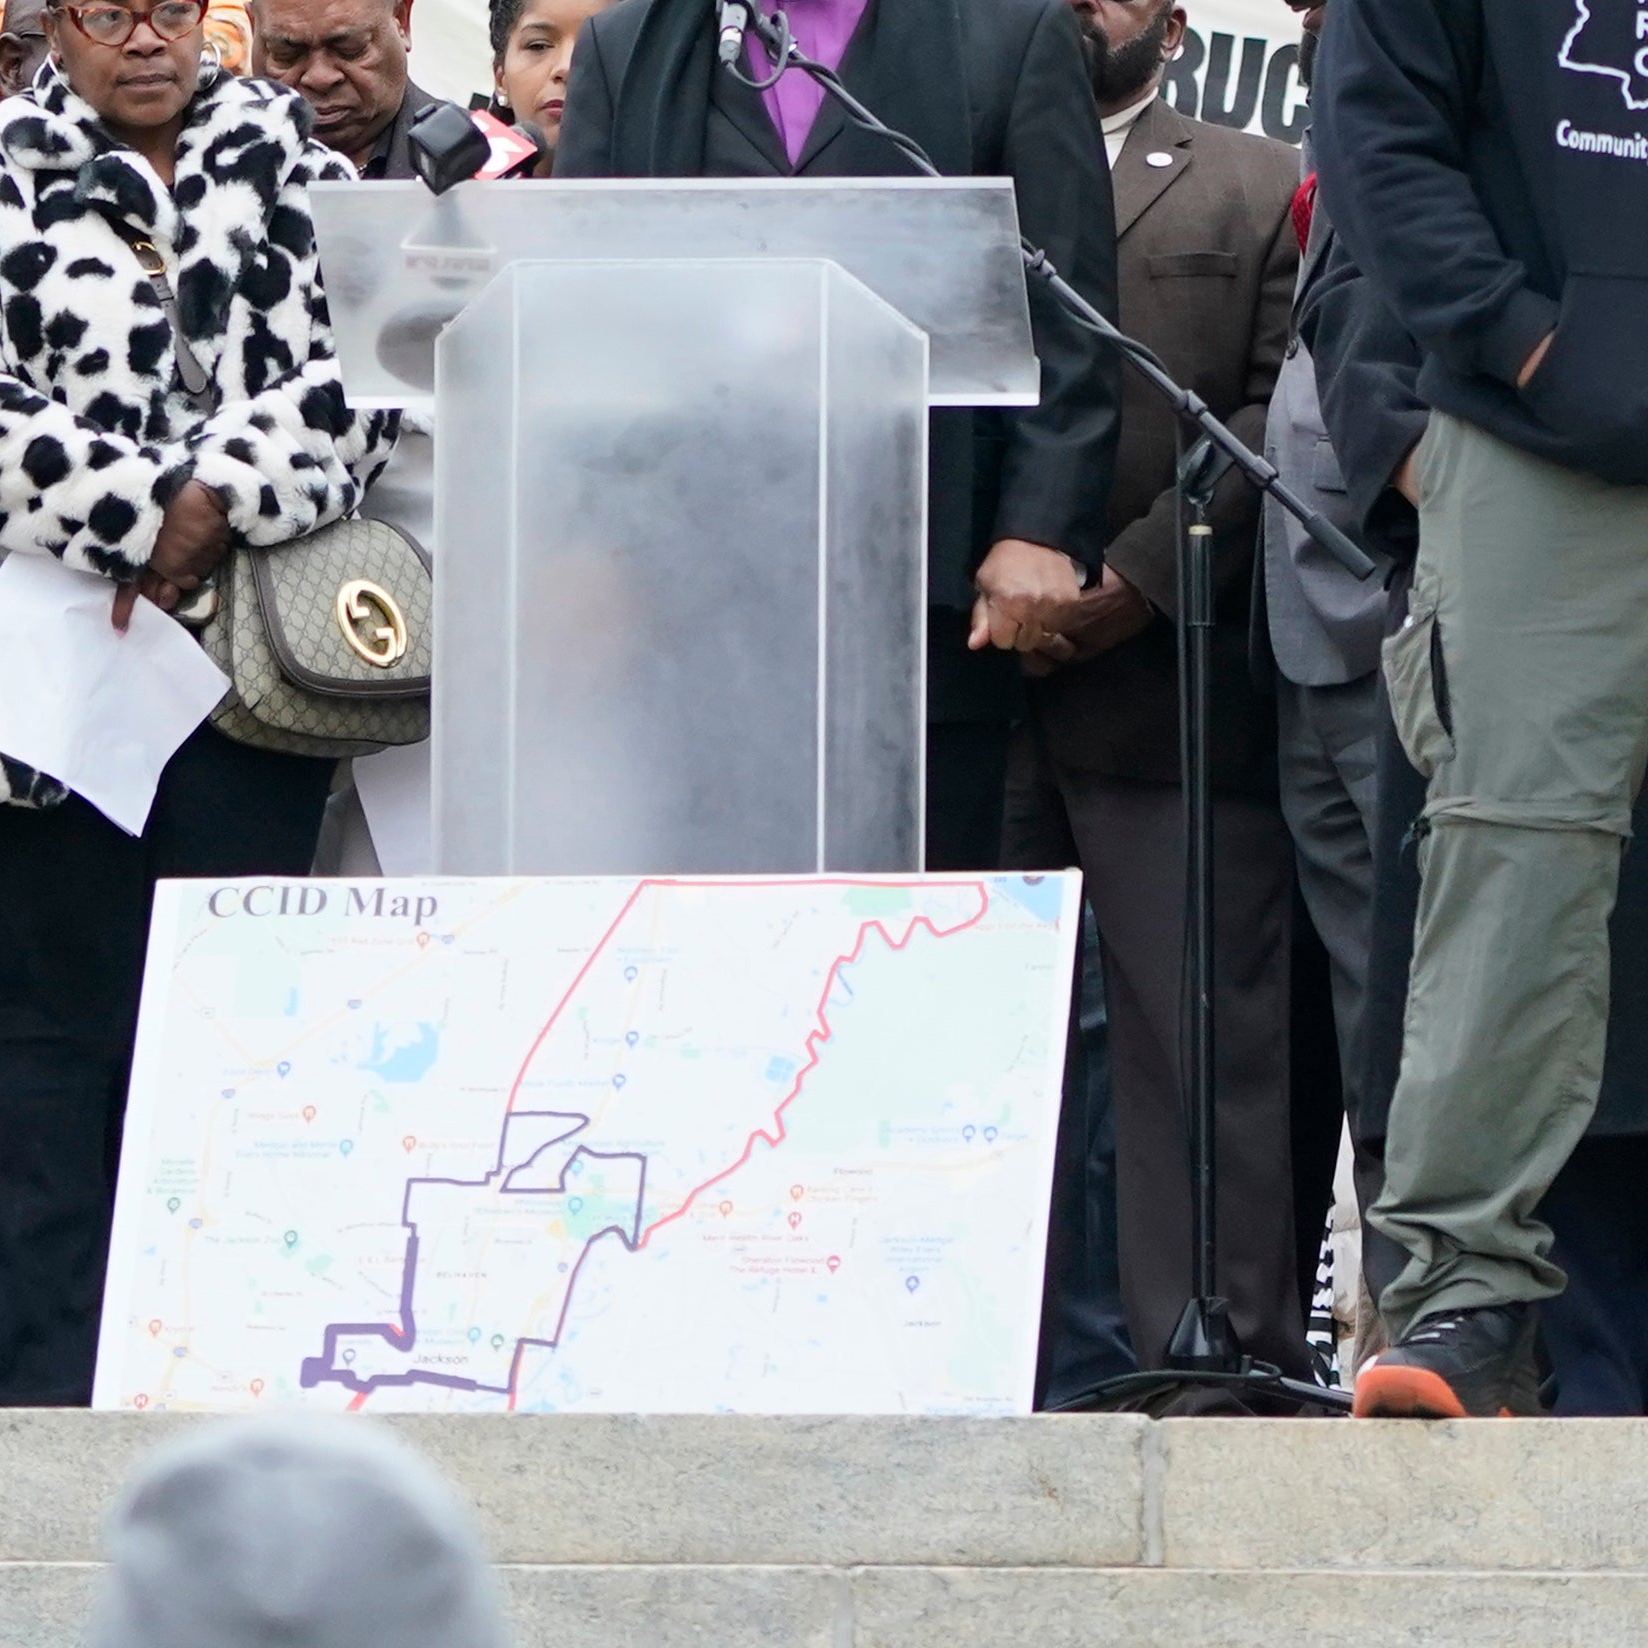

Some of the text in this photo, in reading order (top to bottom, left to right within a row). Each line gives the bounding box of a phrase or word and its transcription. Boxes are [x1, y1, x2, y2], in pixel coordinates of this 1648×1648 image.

[208, 886, 439, 926] CCID Map
[413, 1353, 469, 1365] Jackson
